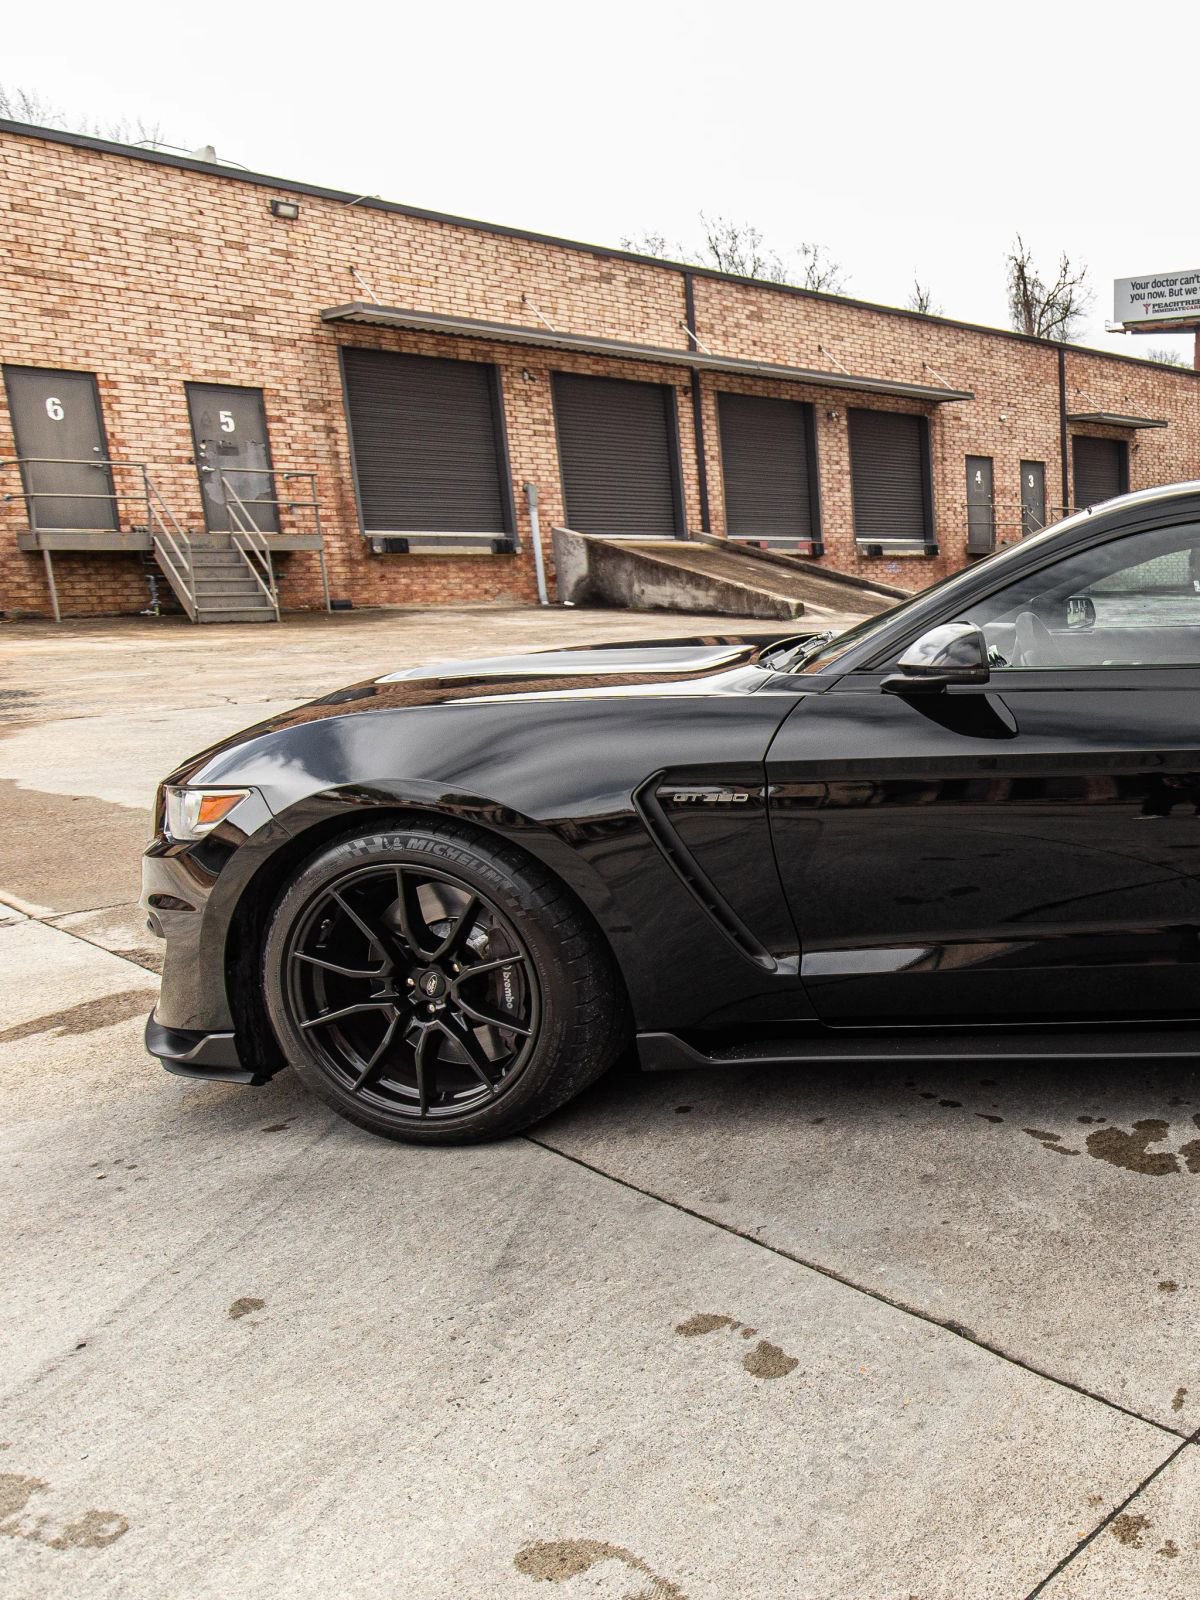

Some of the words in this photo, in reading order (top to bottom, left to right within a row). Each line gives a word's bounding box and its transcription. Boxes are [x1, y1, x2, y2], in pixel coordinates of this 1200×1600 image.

[1131, 281, 1149, 291] Your
[1151, 278, 1178, 289] doctor
[1180, 274, 1200, 285] can't
[1130, 293, 1145, 303] you
[1147, 290, 1167, 299] now.
[1168, 288, 1183, 297] But
[1185, 286, 1198, 295] we
[46, 397, 64, 420] 6
[219, 410, 235, 432] 5
[975, 471, 981, 484] 4
[1028, 475, 1034, 488] 3
[406, 838, 503, 882] MICHELIN
[503, 972, 514, 1009] brembo
